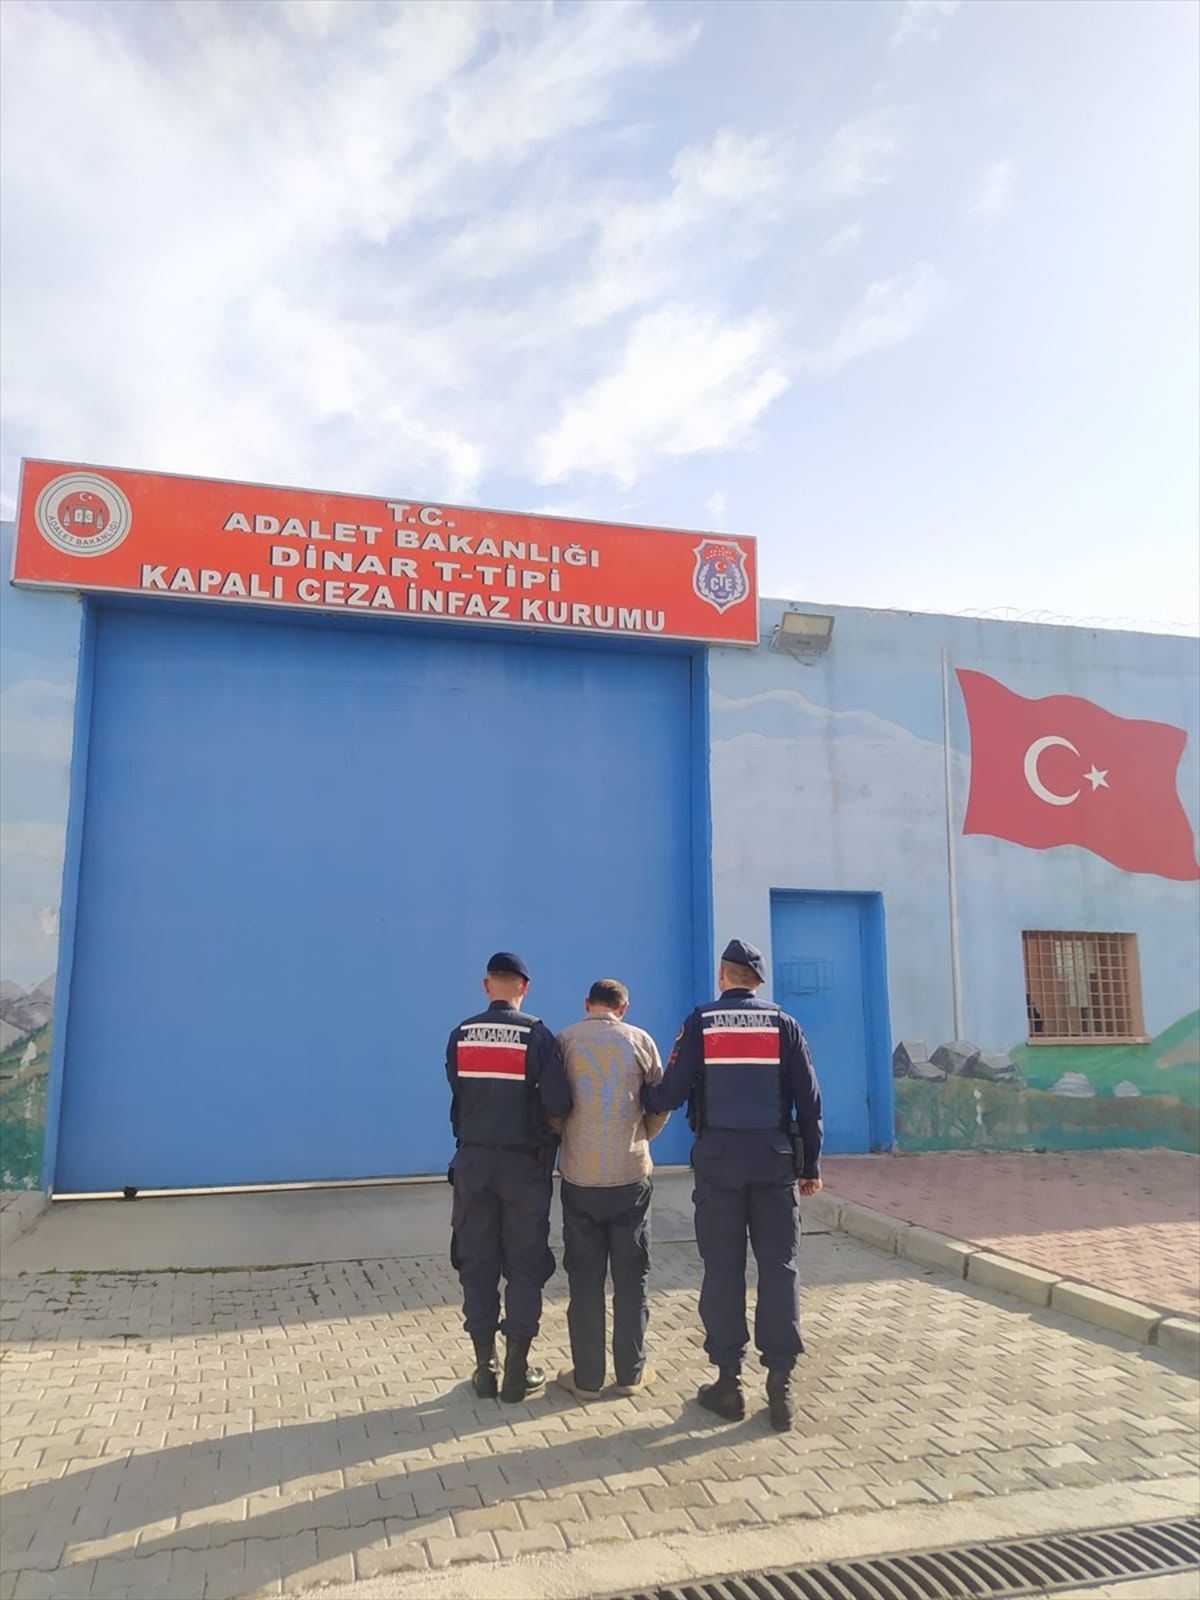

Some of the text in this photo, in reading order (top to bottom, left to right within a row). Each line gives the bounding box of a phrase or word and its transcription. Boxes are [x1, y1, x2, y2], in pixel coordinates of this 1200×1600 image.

[387, 503, 455, 527] T.C.
[48, 515, 74, 542] ADALET
[223, 512, 599, 567] ADALET BAKANLIĞI
[271, 545, 560, 591] DİNAR T-TİPİ
[710, 573, 733, 592] CTE
[141, 565, 665, 632] KAPALI CEZA İNFAZ KURUMU
[710, 1014, 773, 1028] JANDARMA
[463, 1028, 521, 1043] JANDARMA
